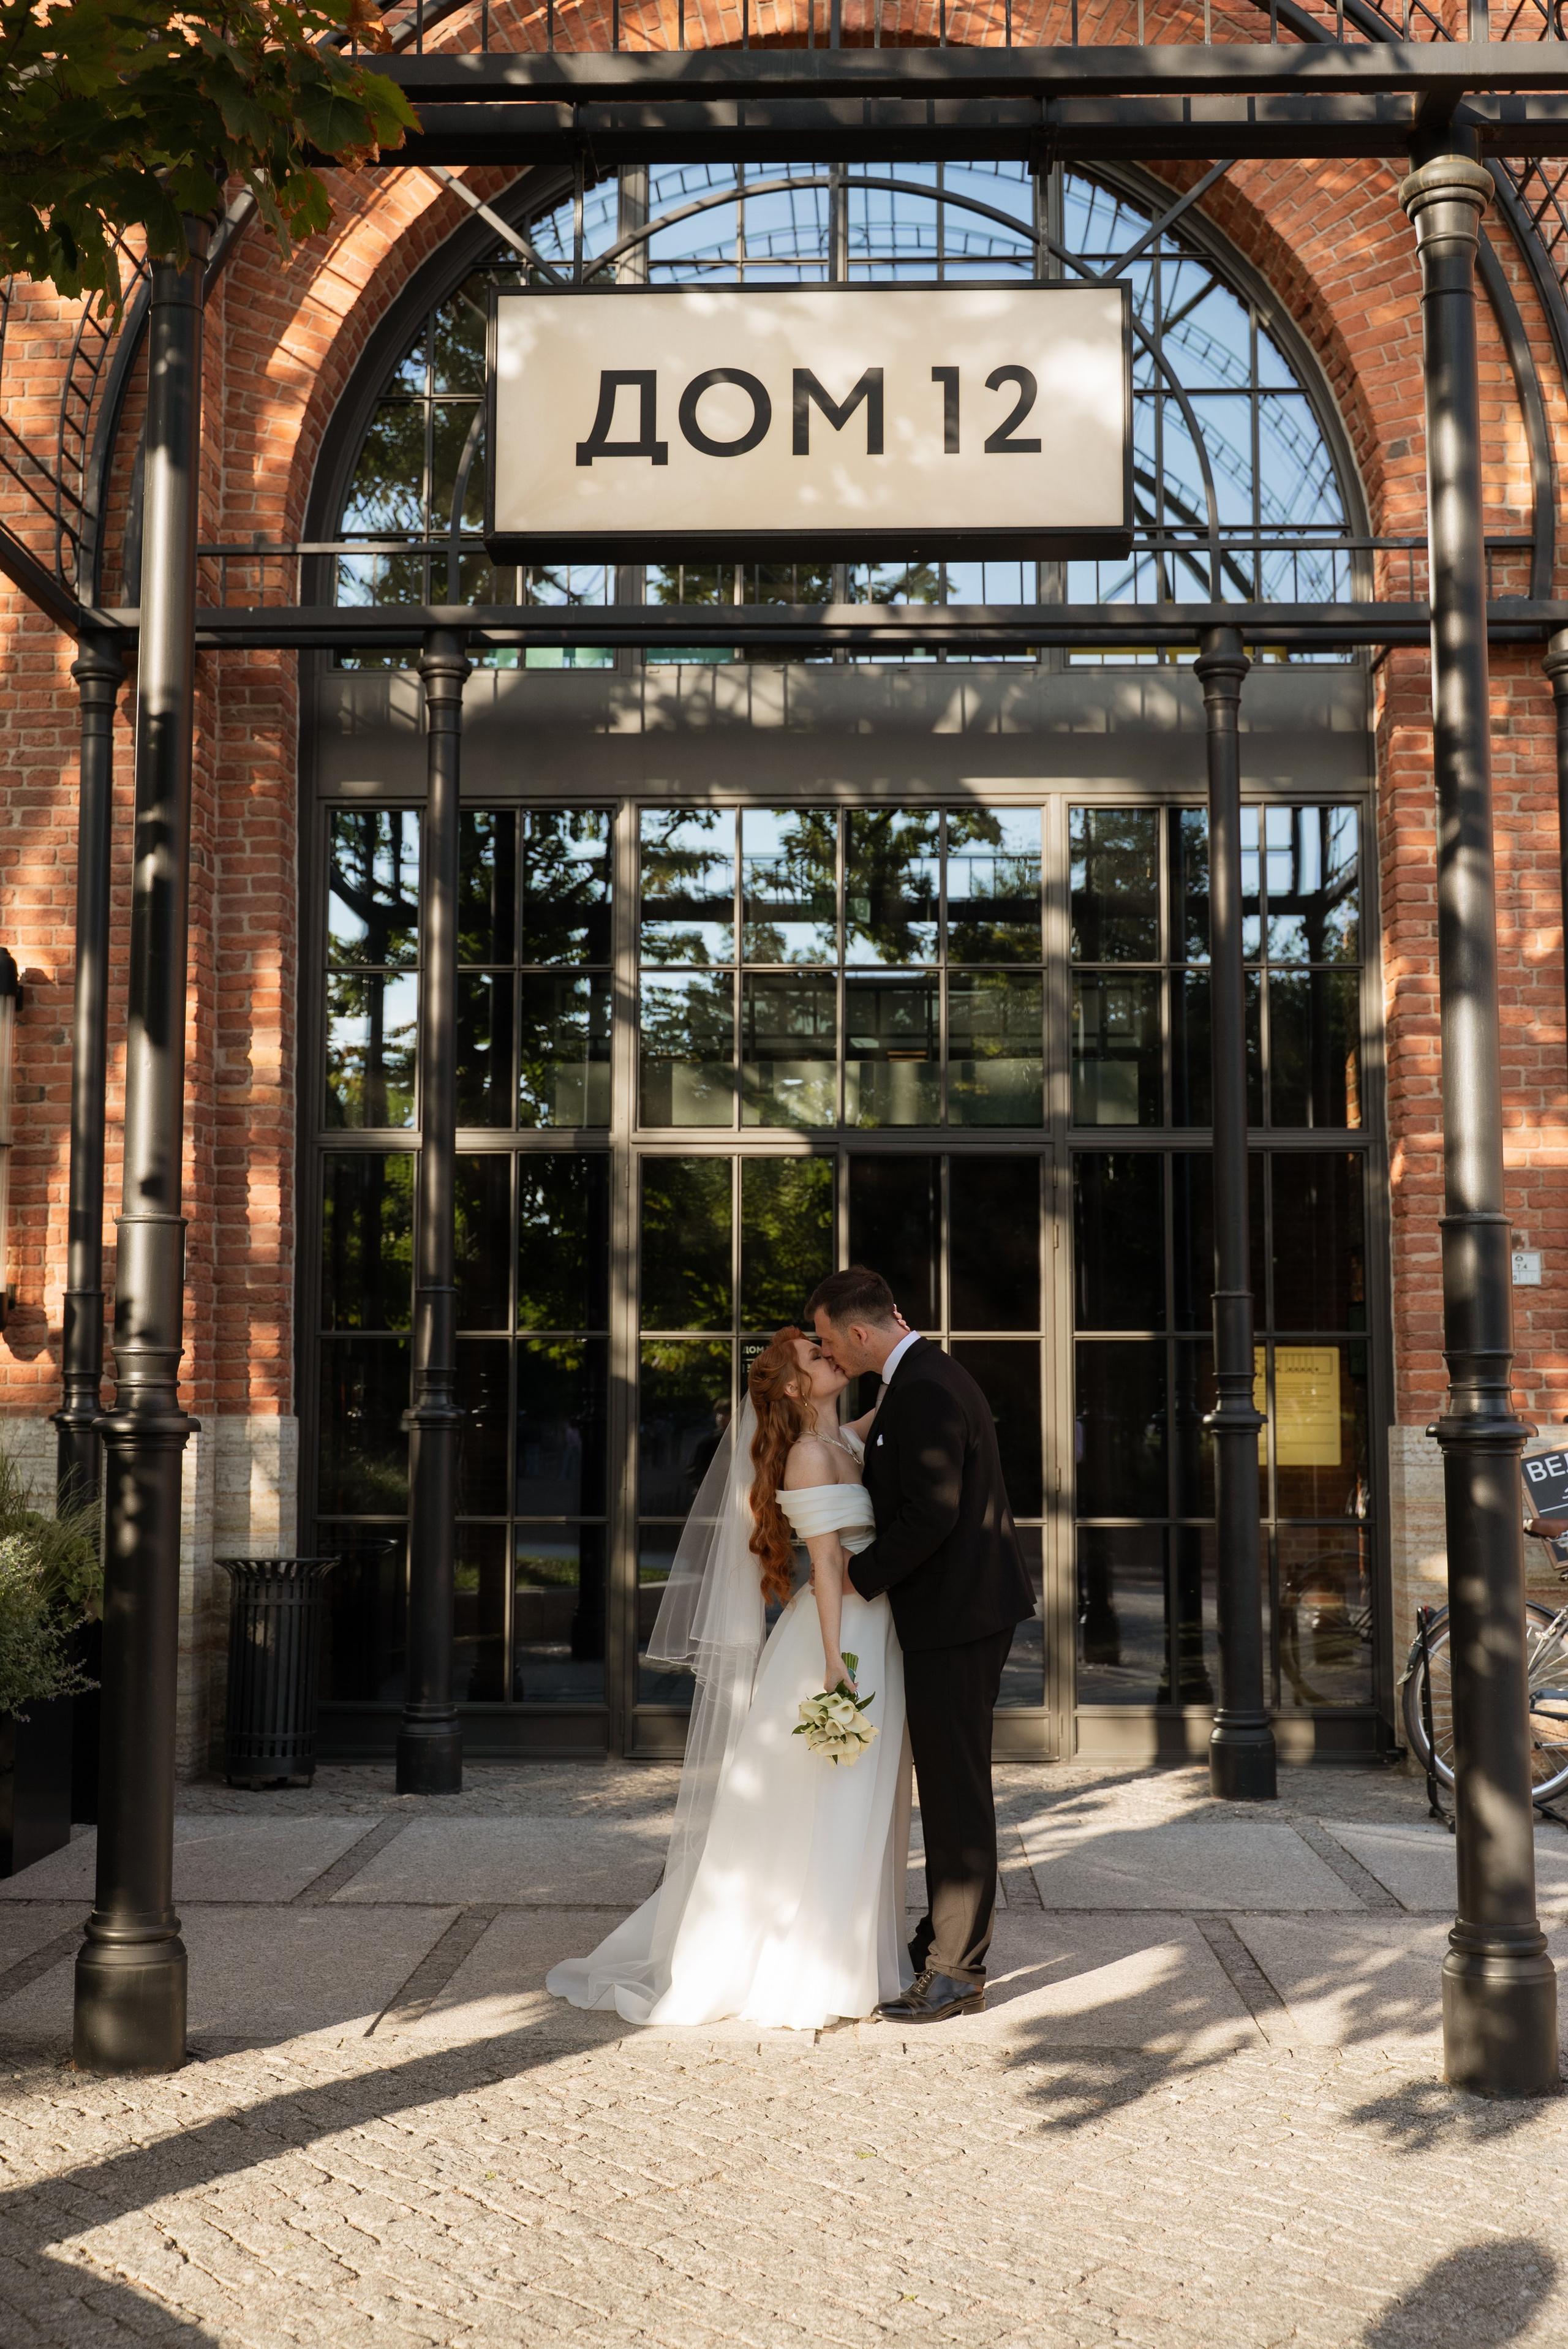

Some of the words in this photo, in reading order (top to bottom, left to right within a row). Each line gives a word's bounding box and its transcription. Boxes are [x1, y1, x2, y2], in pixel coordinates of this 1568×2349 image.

[576, 367, 884, 467] ДОМ
[931, 364, 1042, 454] 12
[1526, 1453, 1568, 1482] ВЕ
